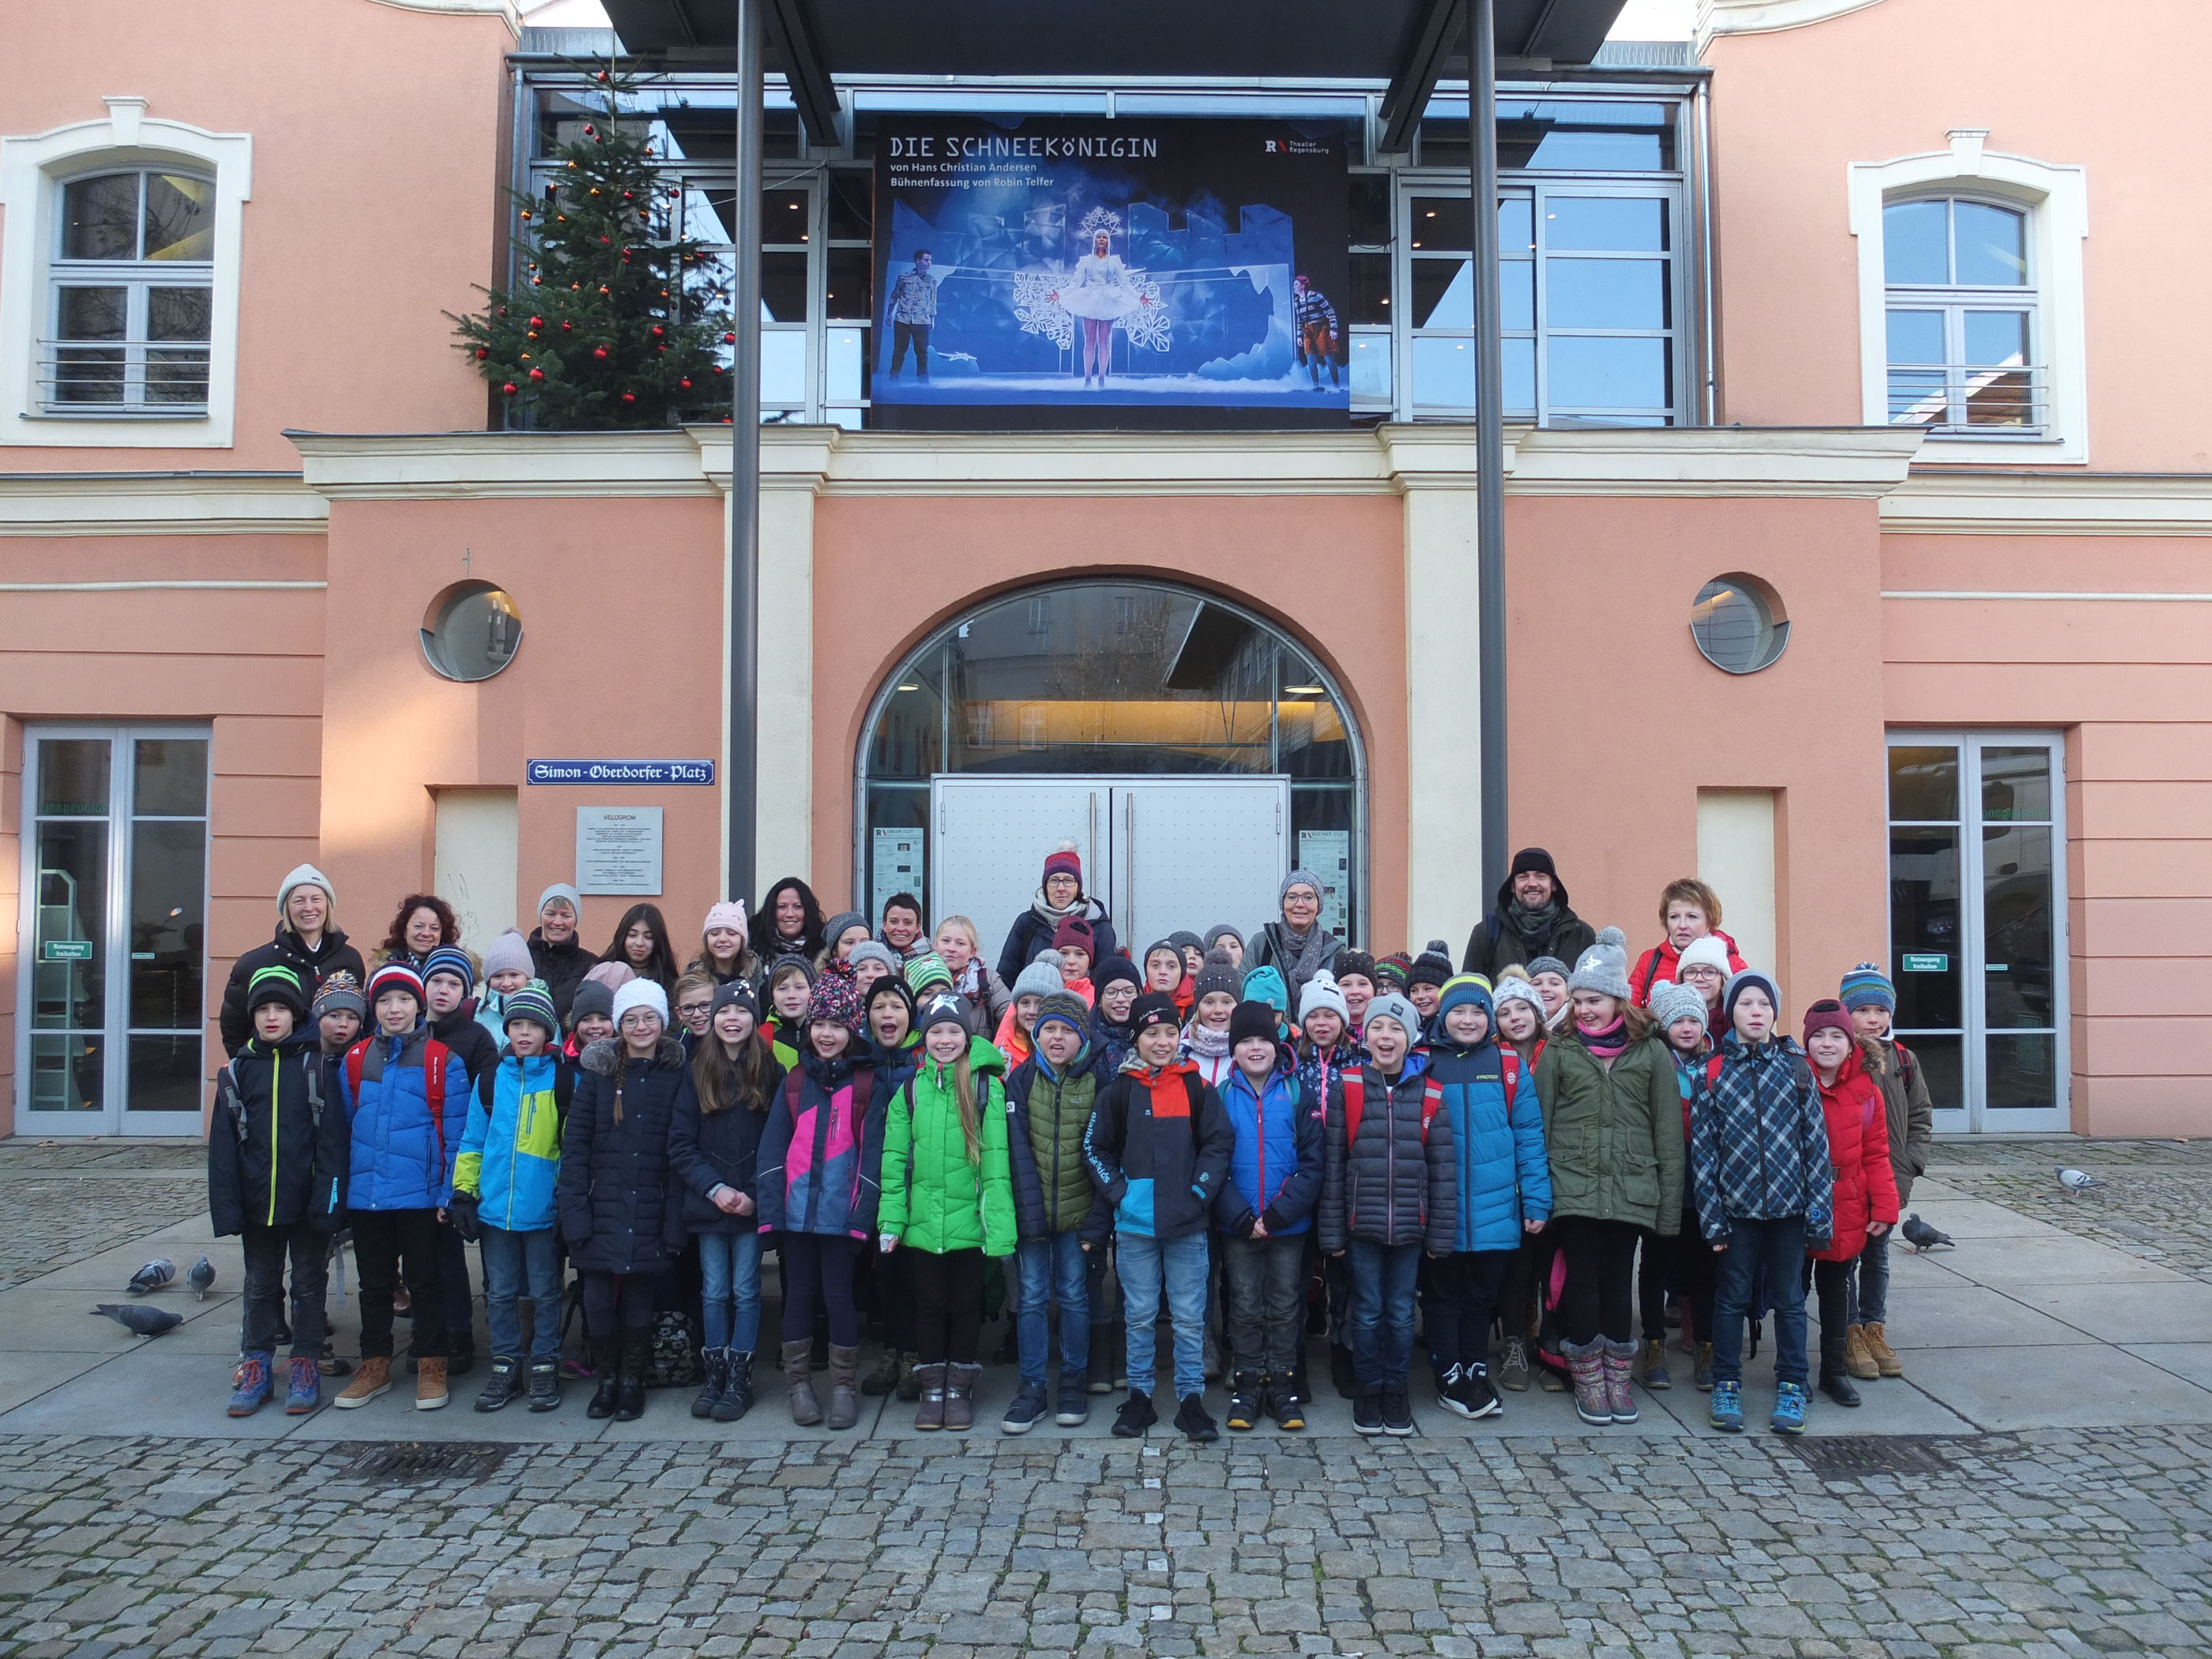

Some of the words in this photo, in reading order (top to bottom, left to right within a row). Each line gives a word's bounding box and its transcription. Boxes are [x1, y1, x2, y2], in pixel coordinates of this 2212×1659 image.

[890, 137, 934, 156] DIE
[946, 137, 1157, 157] SCHNEEKÖNIGIN
[912, 163, 937, 171] Hans
[940, 163, 986, 171] Christian
[989, 163, 1036, 171] Andersen
[890, 178, 969, 189] Bühnenfassung
[993, 178, 1023, 186] Robin
[1025, 178, 1054, 186] Telfer
